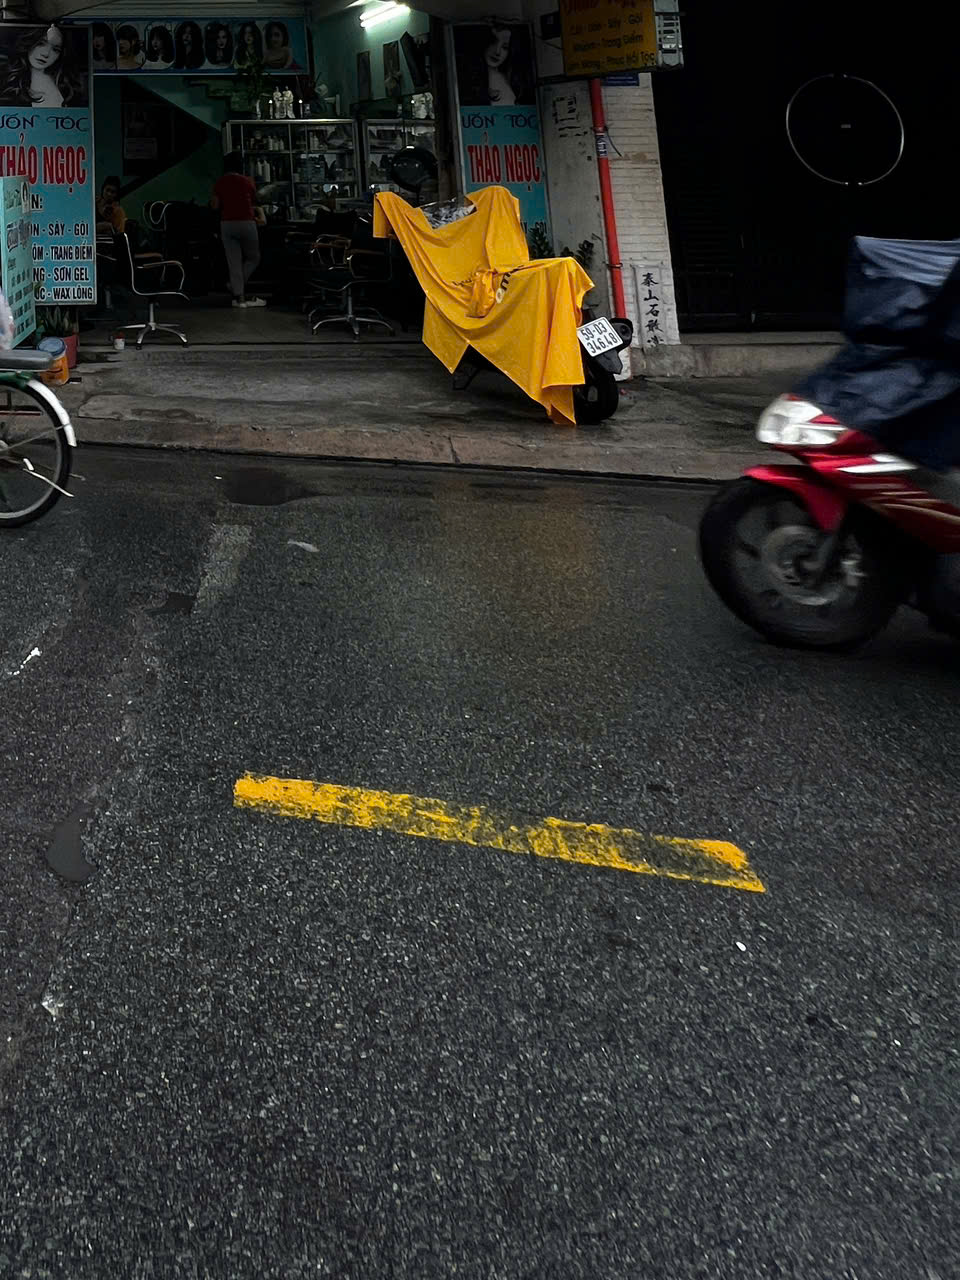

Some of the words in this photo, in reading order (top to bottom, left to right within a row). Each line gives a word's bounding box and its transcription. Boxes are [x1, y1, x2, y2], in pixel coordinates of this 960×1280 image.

[43, 146, 86, 193] NGỌC
[467, 131, 501, 182] THẢO
[504, 144, 540, 191] NGỌC
[50, 246, 73, 260] TRANG
[53, 266, 71, 281] SƠN
[74, 267, 89, 281] GEL
[53, 287, 70, 299] WAX
[586, 332, 618, 354] 346.48
